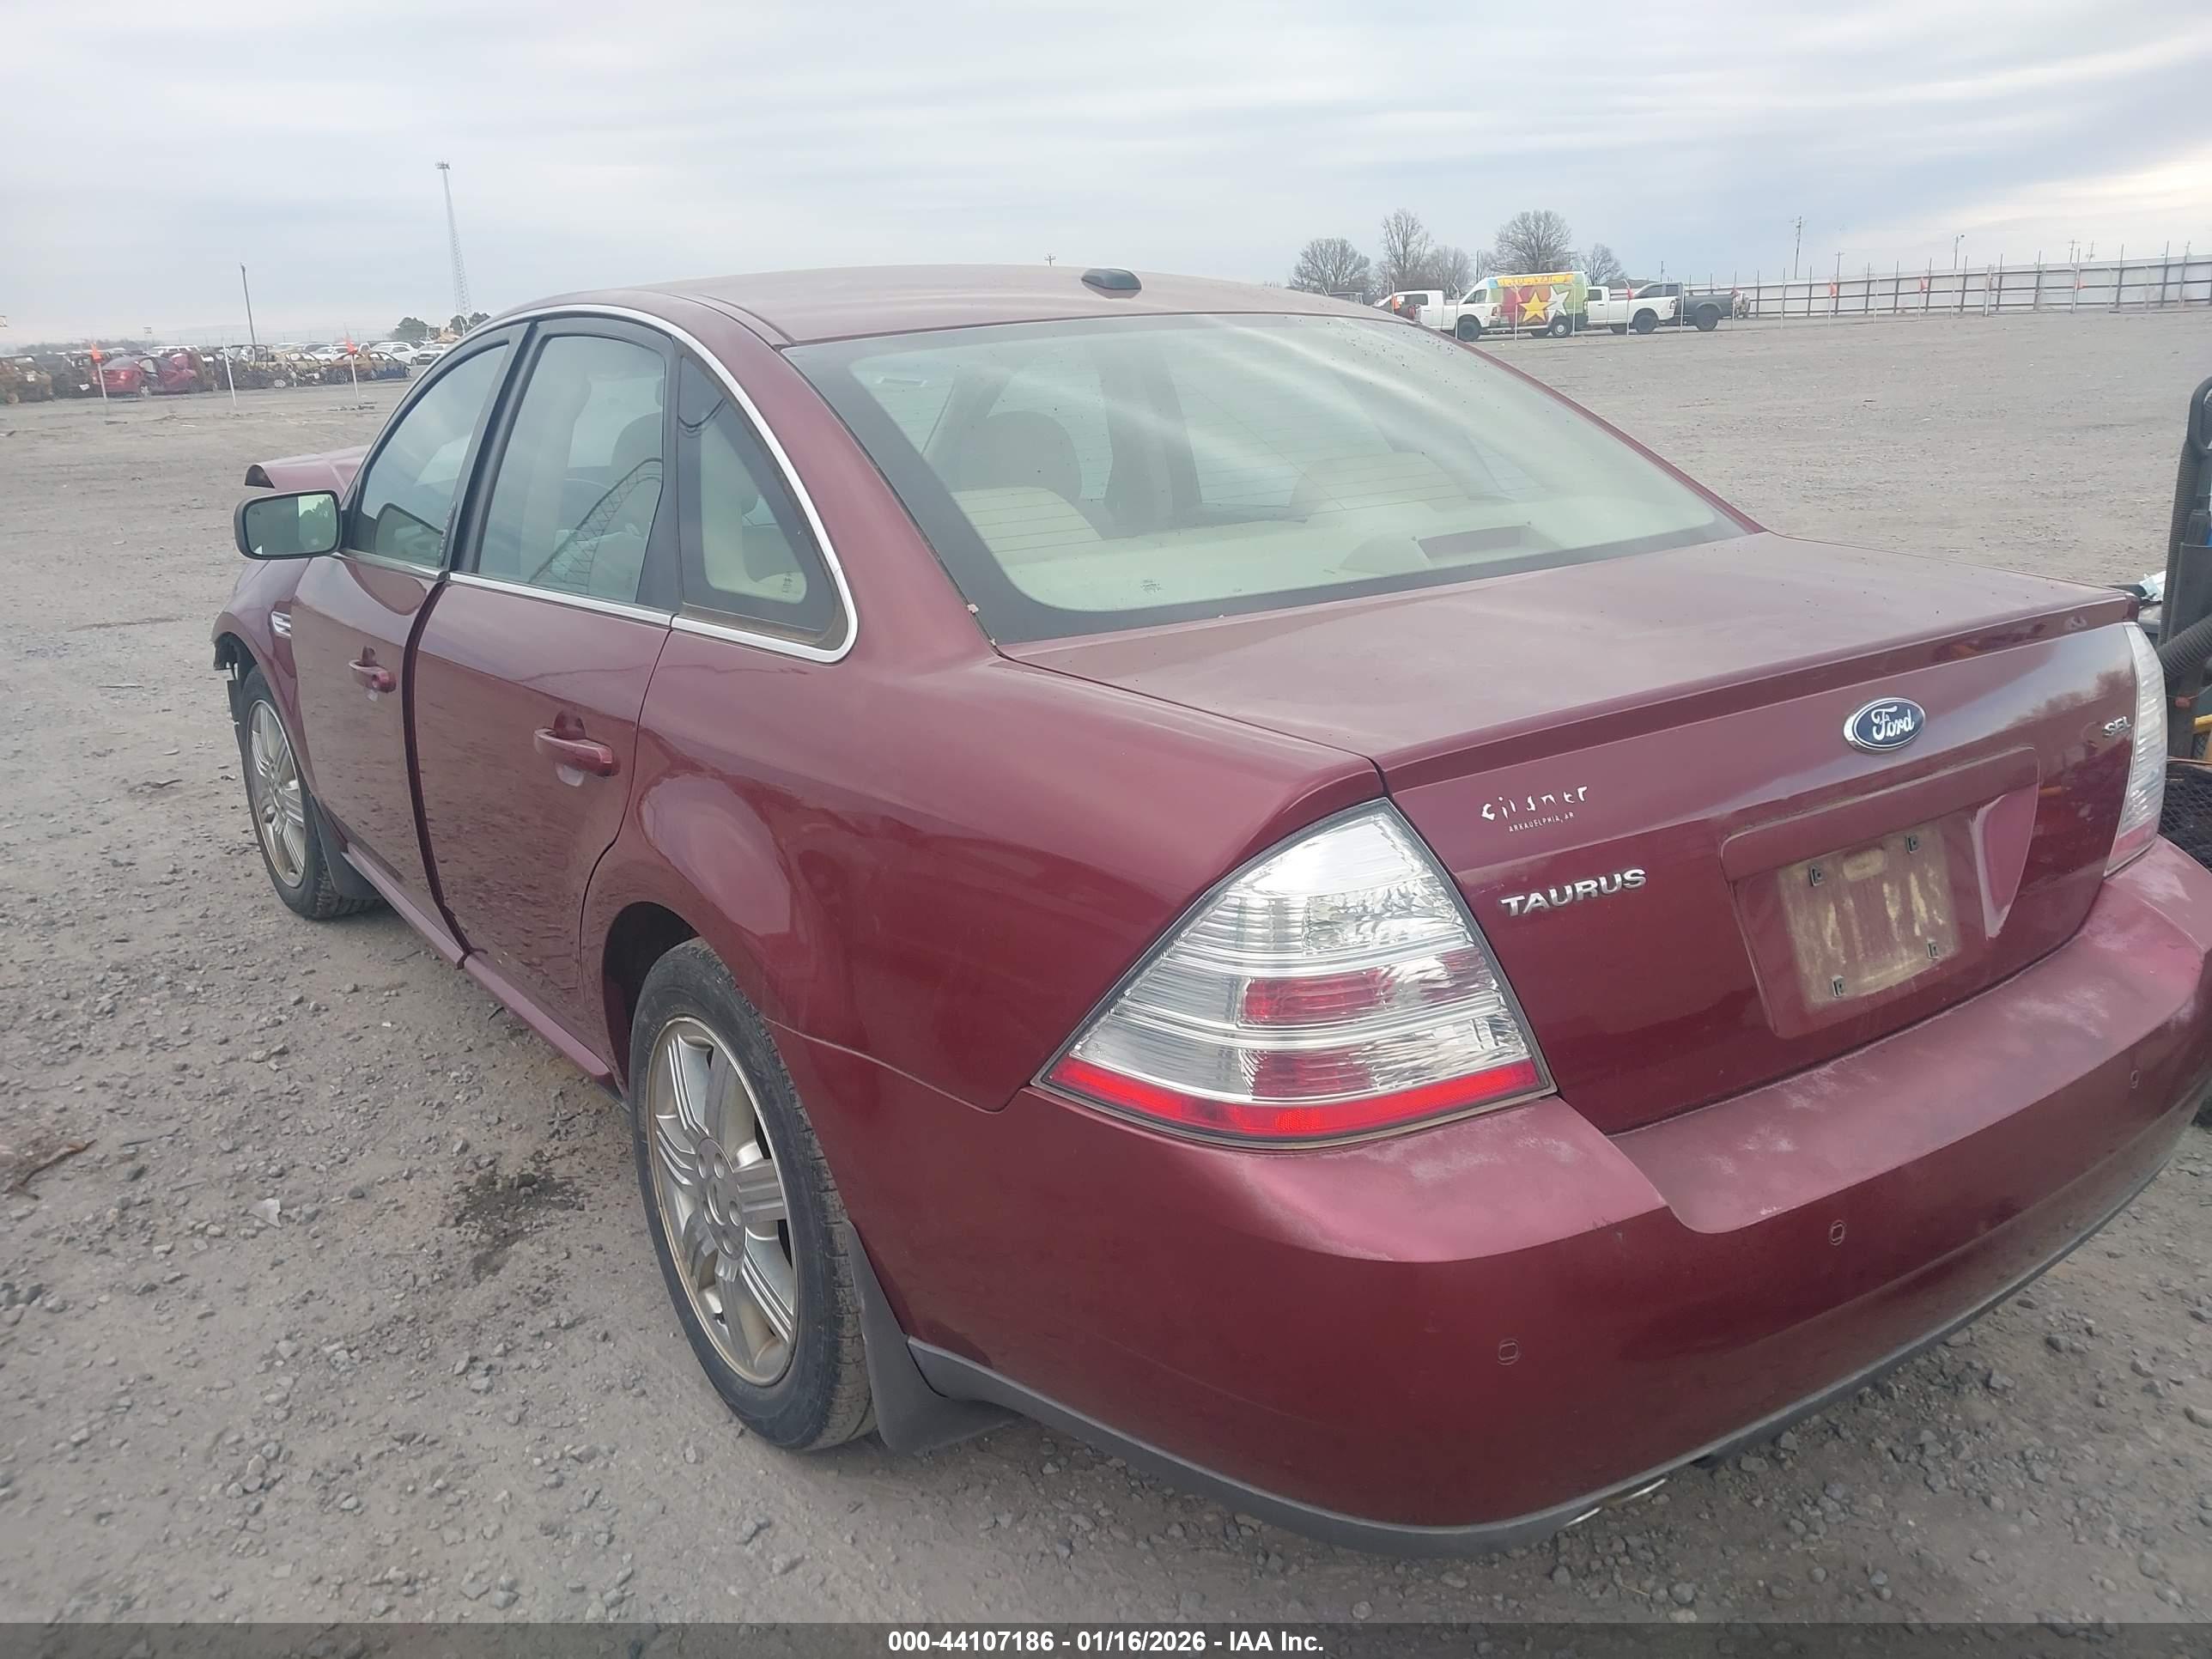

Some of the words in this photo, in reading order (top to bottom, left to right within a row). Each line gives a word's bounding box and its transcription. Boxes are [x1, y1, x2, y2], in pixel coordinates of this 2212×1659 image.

[1870, 705, 1915, 741] Ford
[2104, 715, 2132, 736] SEL
[1565, 811, 1575, 820] AR
[1500, 868, 1647, 917] TAURUS
